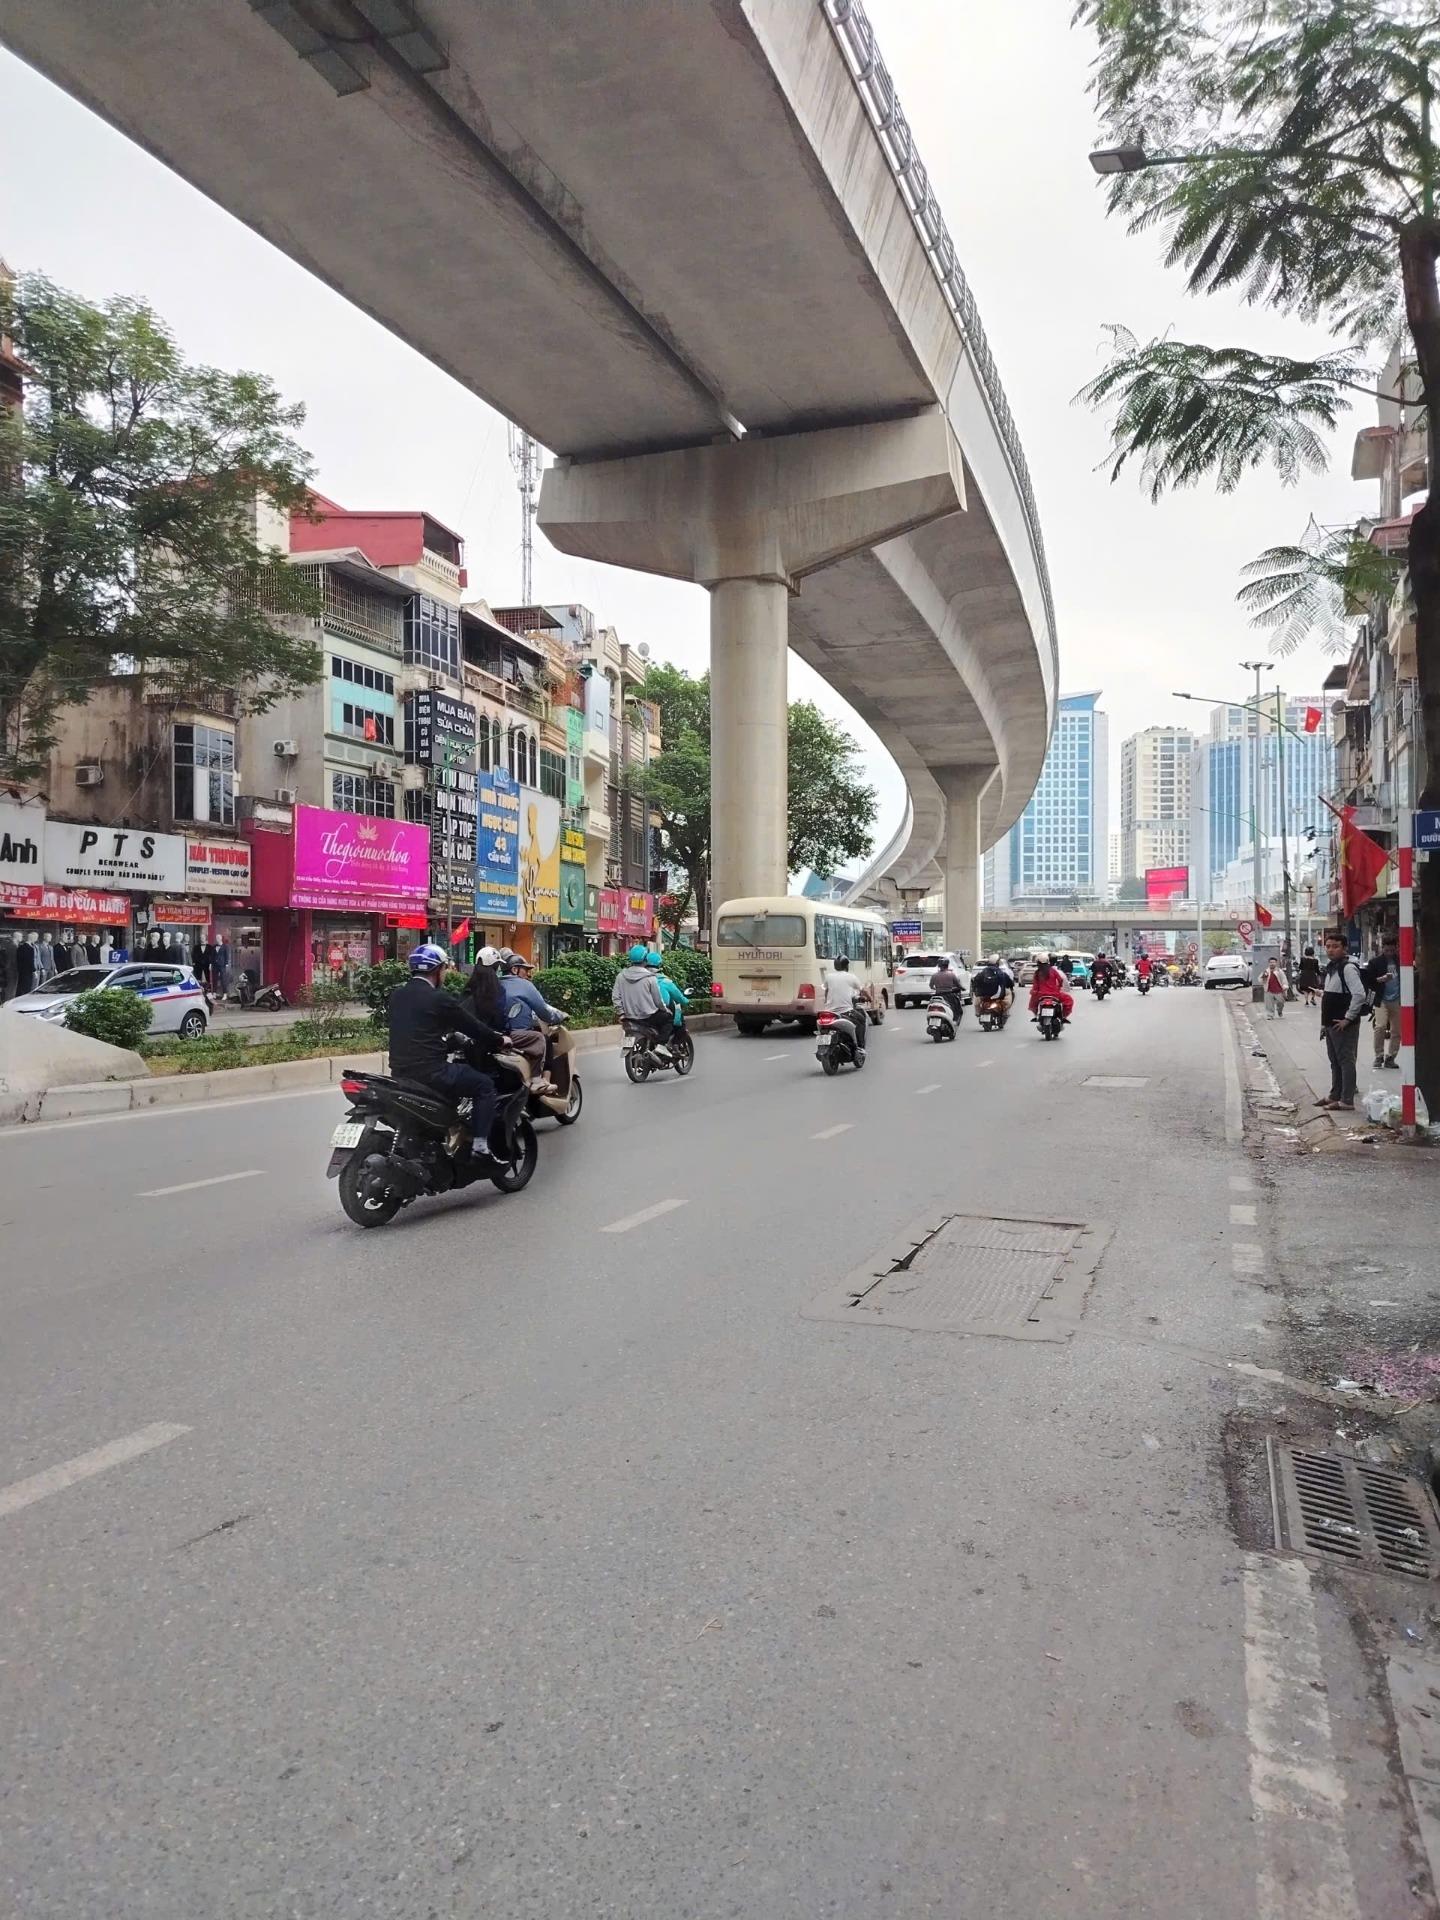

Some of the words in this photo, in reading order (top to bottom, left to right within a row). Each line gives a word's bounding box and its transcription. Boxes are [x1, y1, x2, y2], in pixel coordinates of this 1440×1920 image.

[437, 700, 456, 717] MUA
[457, 707, 475, 723] BÁN
[437, 716, 453, 731] SỬA
[454, 723, 475, 738] CHỮA
[458, 772, 475, 793] MUA
[459, 820, 473, 838] TOP
[0, 833, 38, 864] Anh
[442, 839, 455, 859] GÁ
[456, 843, 472, 861] CAO
[457, 873, 475, 887] BÁN
[738, 951, 783, 960] HYUNDAI
